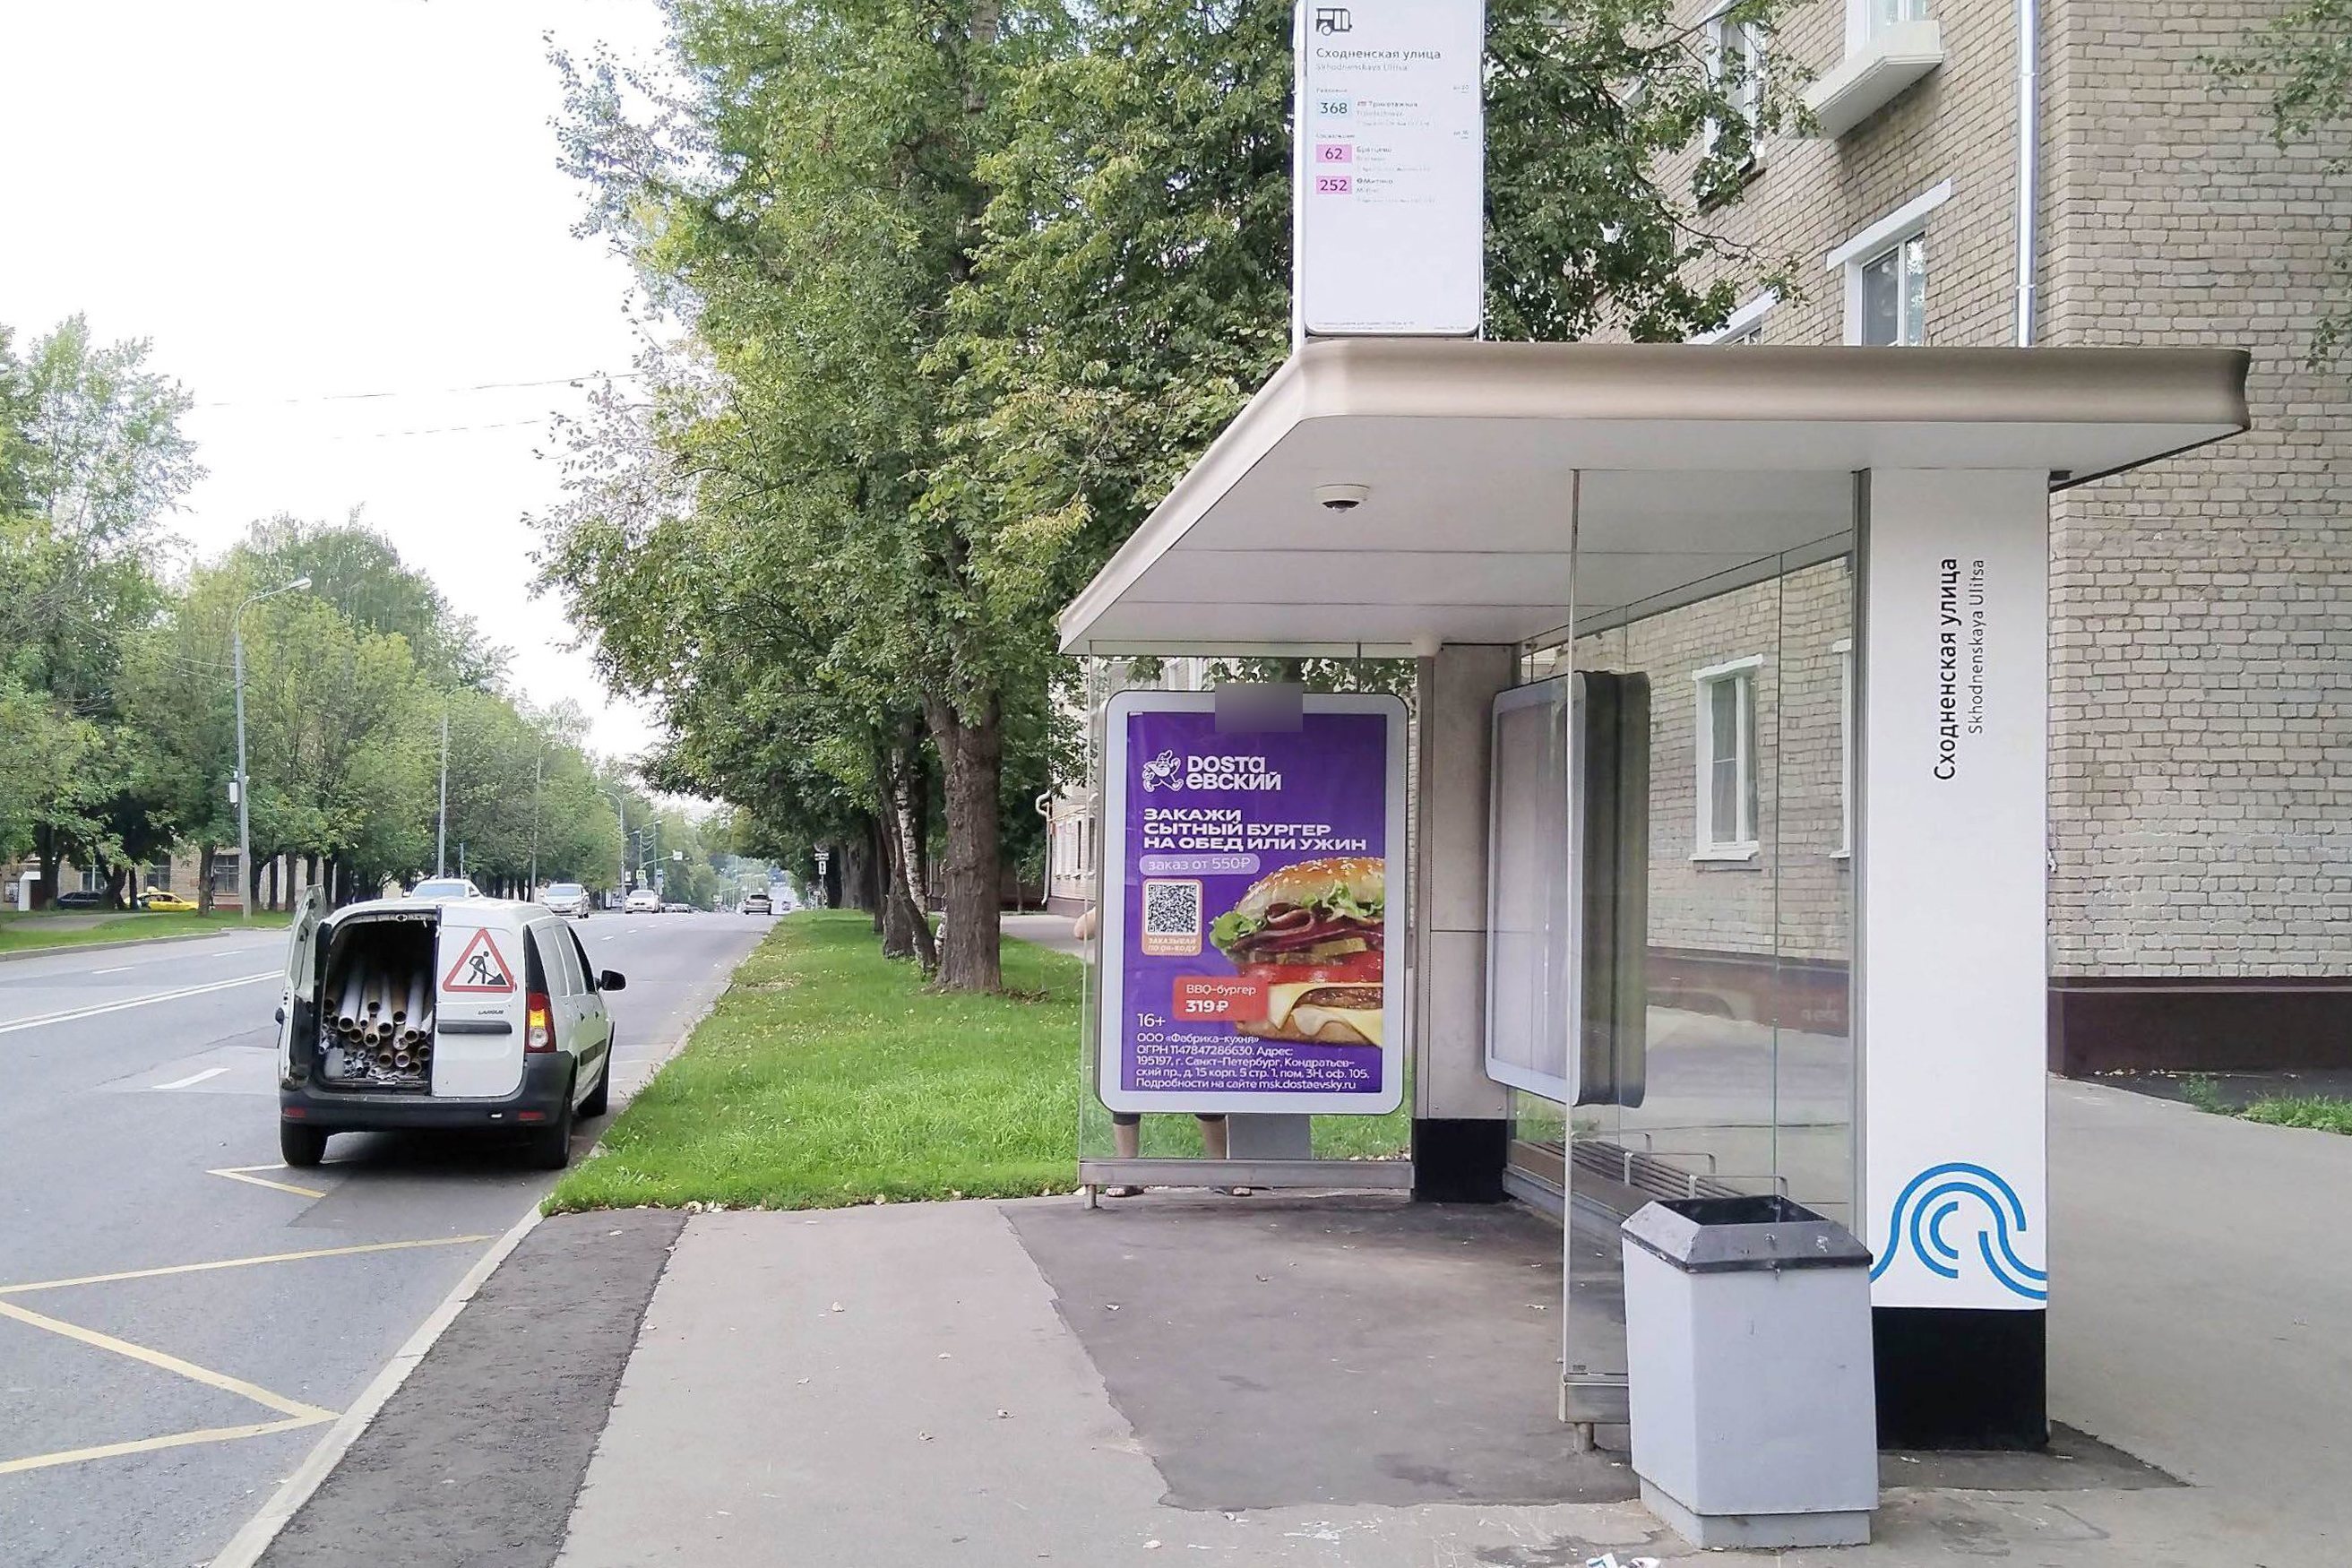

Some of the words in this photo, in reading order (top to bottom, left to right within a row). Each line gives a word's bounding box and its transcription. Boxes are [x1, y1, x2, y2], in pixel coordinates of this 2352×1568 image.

[1316, 47, 1400, 59] Сходненская
[1403, 51, 1442, 60] улица
[1320, 102, 1348, 114] 368
[1325, 148, 1343, 159] 62
[1320, 179, 1348, 192] 252
[1969, 560, 1984, 606] Ulitsa
[1941, 558, 1961, 626] улица
[1968, 611, 1986, 734] Skhodnenskaya
[1934, 632, 1960, 780] Сходненская
[1143, 808, 1242, 821] ЗАКАЖИ
[1143, 820, 1243, 836] СЫТНЫЙ
[1247, 824, 1331, 837] БУРГЕР
[1143, 837, 1176, 849] НА
[1178, 837, 1244, 851] ОБЕД
[1247, 838, 1296, 850] ИЛИ
[1299, 839, 1366, 851] УЖИН
[1148, 860, 1189, 870] заказ
[1193, 860, 1209, 870] от
[1185, 984, 1257, 996] BBQ-бургер
[1185, 999, 1229, 1013] 319₽
[1137, 1013, 1166, 1028] 16+
[1137, 1033, 1164, 1042] ООО
[1165, 1033, 1260, 1046] «Фабрика-кухня»
[1137, 1045, 1168, 1055] ОГРН
[1256, 1047, 1294, 1057] Адрес:
[1176, 1058, 1184, 1066] г.
[1285, 1057, 1355, 1069] Кондратьев-
[1136, 1067, 1162, 1077] ский
[1195, 1067, 1207, 1077] 15
[1239, 1067, 1247, 1077] 5
[1248, 1070, 1270, 1080] стр.
[1326, 1069, 1347, 1080] оф.
[1136, 1078, 1211, 1090] Подробности
[1226, 1079, 1257, 1089] сайте
[1259, 1080, 1357, 1091] msk.dostaevsky.ru
